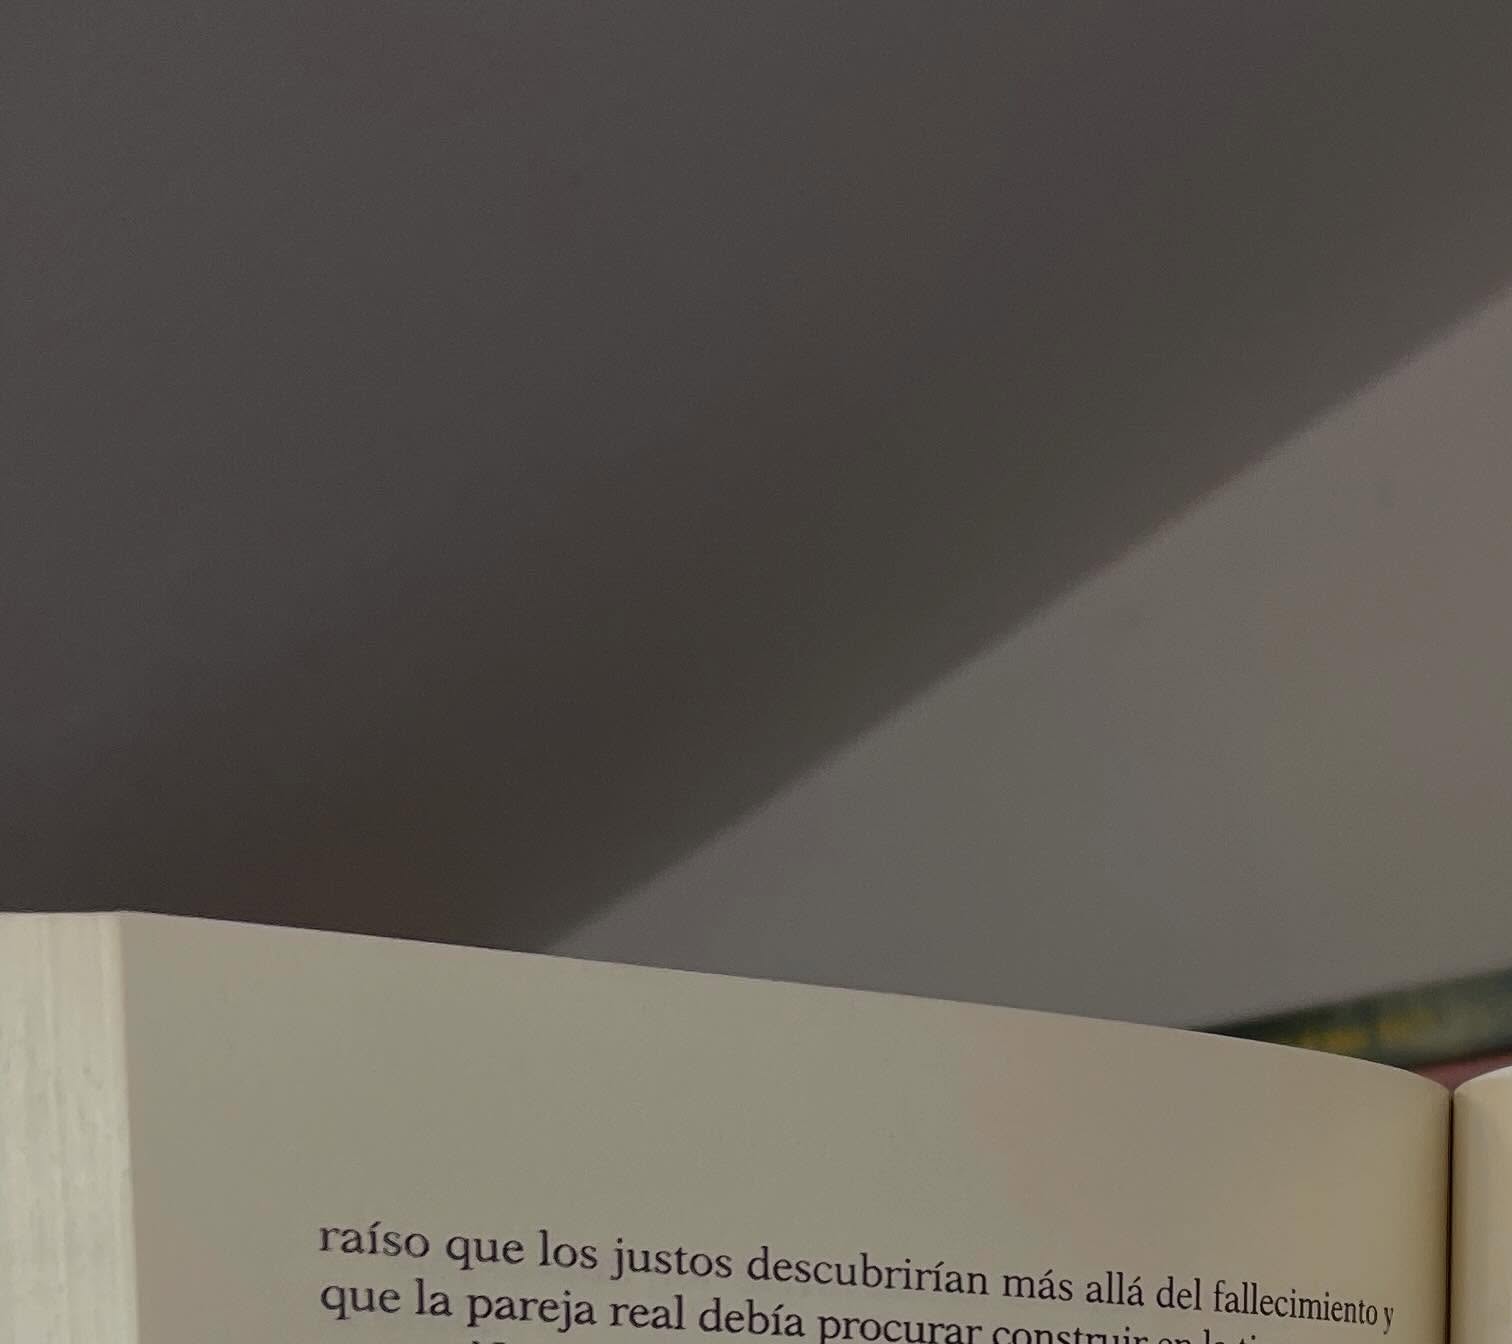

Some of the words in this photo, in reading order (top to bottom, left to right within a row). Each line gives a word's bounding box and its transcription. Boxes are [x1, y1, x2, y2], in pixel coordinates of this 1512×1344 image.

[319, 1220, 431, 1259] raíso
[445, 1235, 525, 1272] que
[538, 1228, 599, 1270] los
[609, 1237, 733, 1281] justos
[746, 1245, 990, 1296] descubrirían
[1001, 1268, 1074, 1302] más
[1085, 1270, 1145, 1308] allá
[1155, 1275, 1203, 1312] del
[1212, 1279, 1378, 1326] fallecimiento
[1383, 1306, 1395, 1336] y
